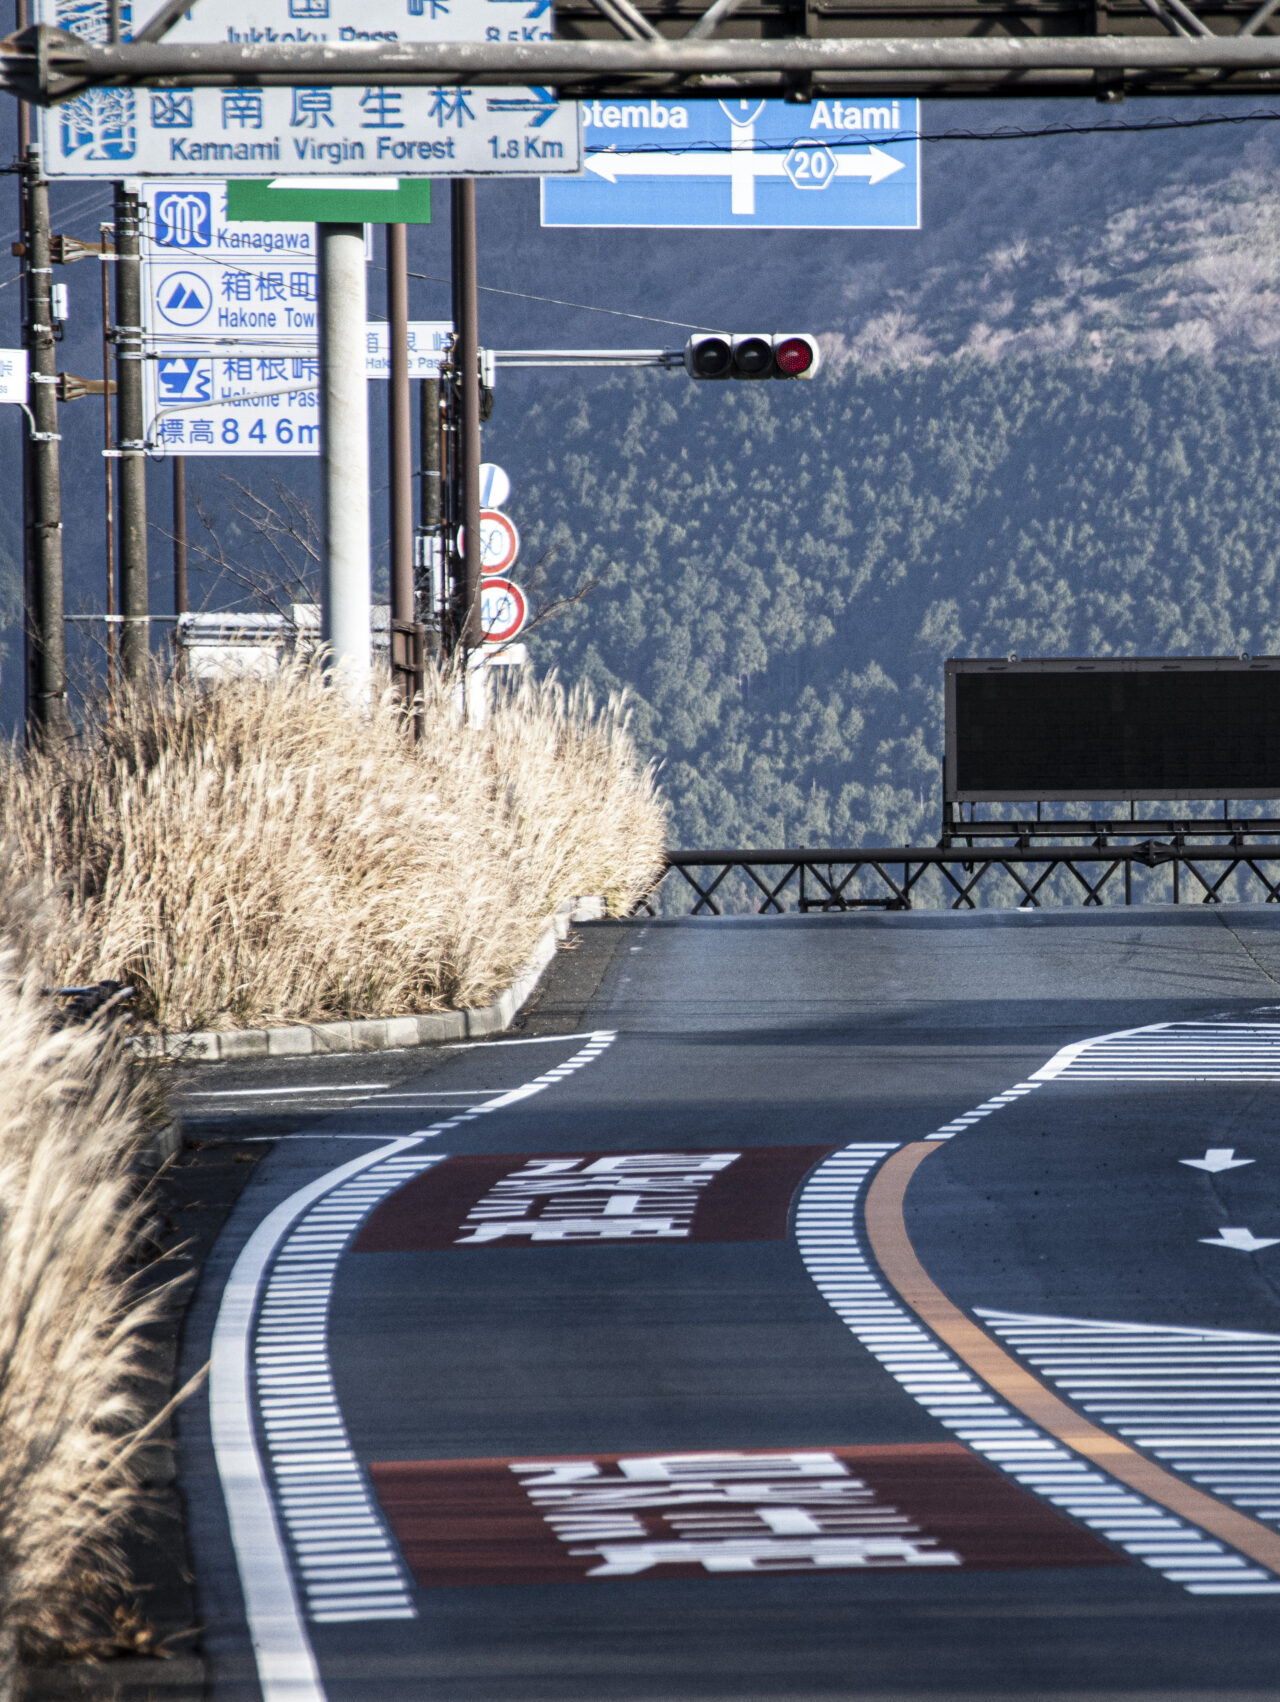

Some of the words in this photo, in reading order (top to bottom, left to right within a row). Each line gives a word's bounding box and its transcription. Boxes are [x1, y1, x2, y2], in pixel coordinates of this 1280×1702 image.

[150, 87, 475, 129] 函南原生林
[583, 101, 688, 128] otemba
[810, 100, 899, 129] Atami
[170, 137, 281, 161] Kannami
[293, 137, 365, 164] Virgin
[376, 136, 456, 159] Forest
[793, 156, 826, 178] 20
[217, 228, 310, 252] Kanagawa
[221, 271, 319, 301] 箱根町
[218, 307, 277, 328] Hakone
[284, 307, 318, 328] Tow
